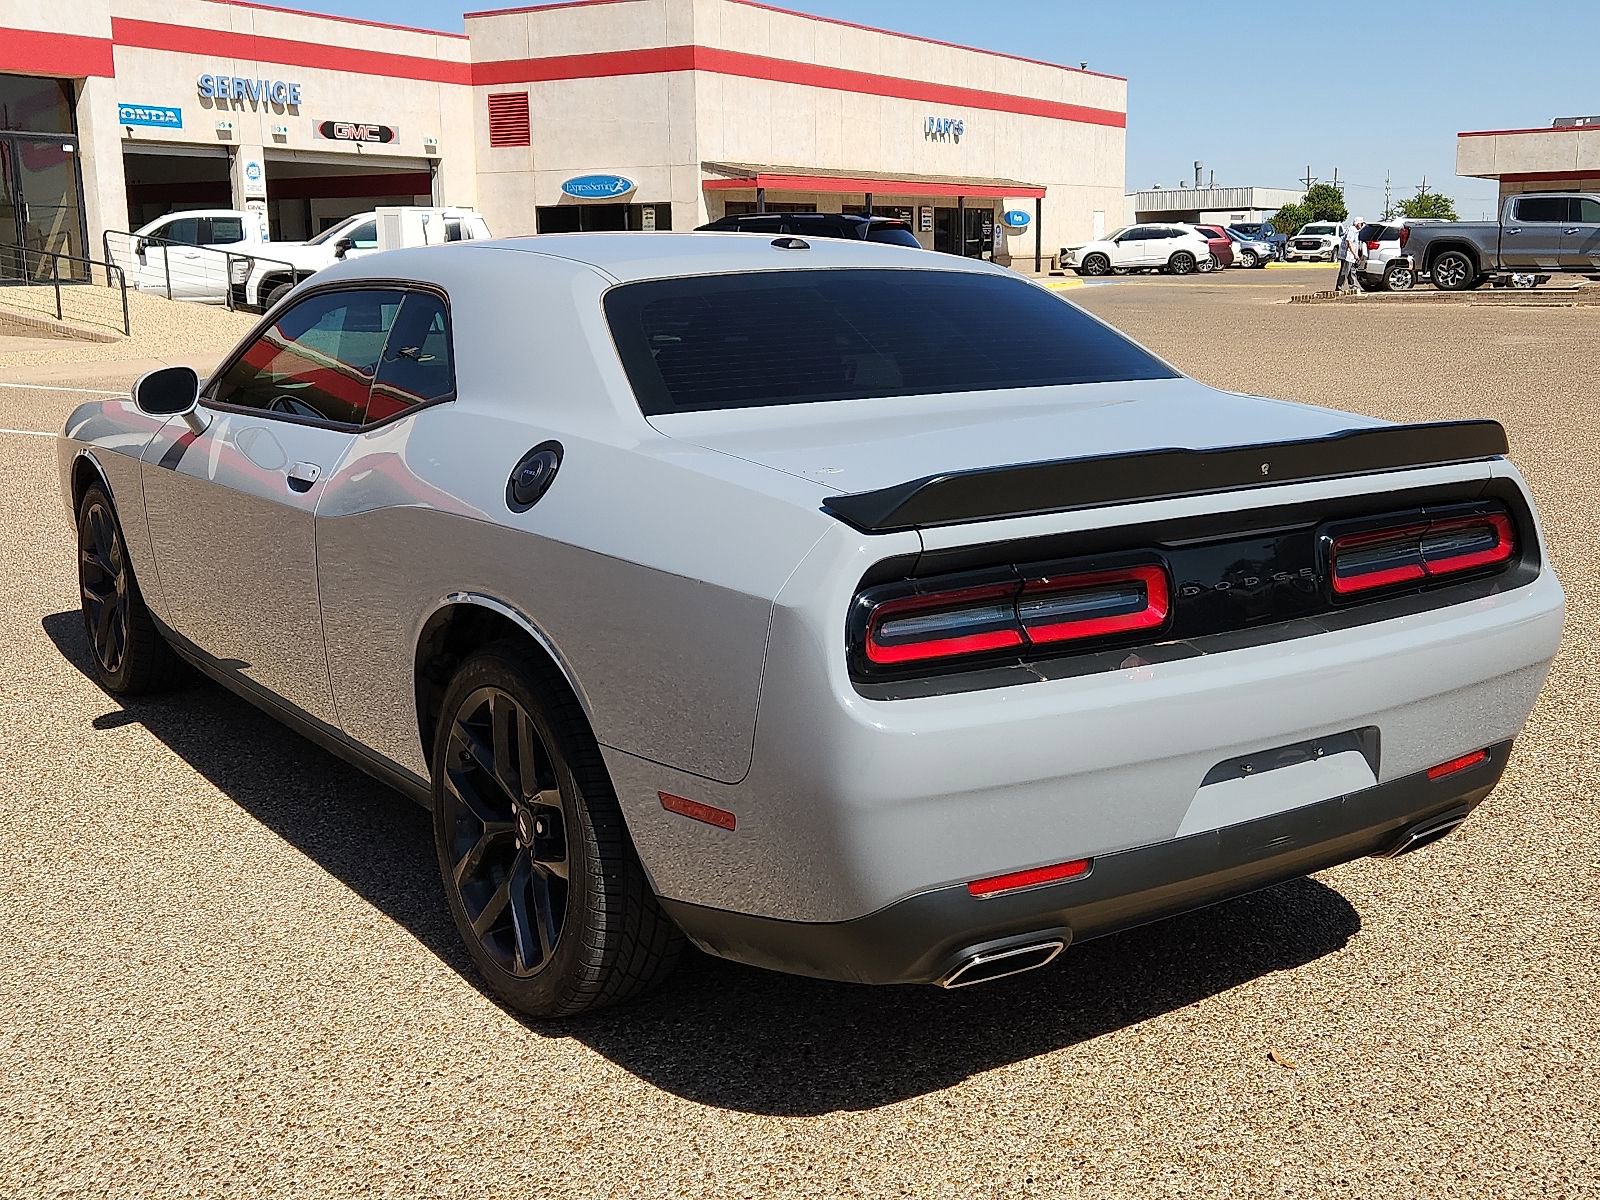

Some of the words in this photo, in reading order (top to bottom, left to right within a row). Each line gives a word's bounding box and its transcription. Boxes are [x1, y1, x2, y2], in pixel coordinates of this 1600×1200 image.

[199, 74, 301, 105] SERVICE
[118, 107, 180, 123] ONDA
[334, 122, 380, 141] GMC
[928, 116, 964, 135] PARTS
[1183, 567, 1313, 596] DODGE
